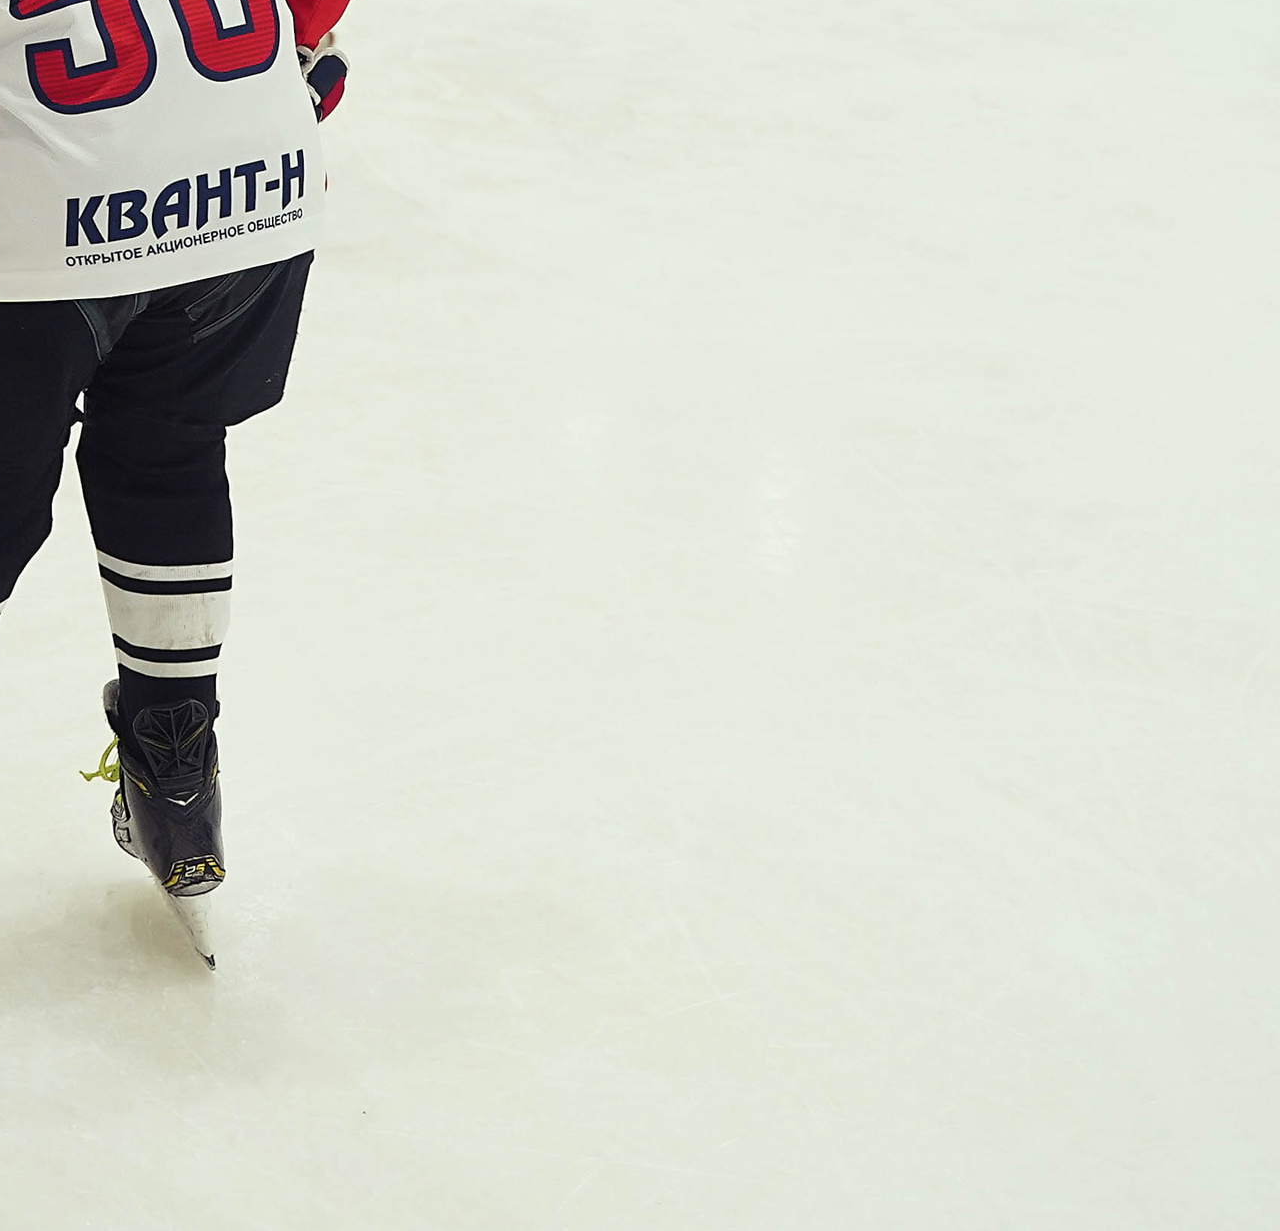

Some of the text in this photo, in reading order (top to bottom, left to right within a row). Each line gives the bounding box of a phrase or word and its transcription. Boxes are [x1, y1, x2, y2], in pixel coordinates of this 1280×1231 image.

[64, 148, 306, 247] КВАНТ-Н
[65, 207, 304, 268] ОТКРЫТОЕ АКЦИОНЕРНОЕ ОБЩЕСТВО
